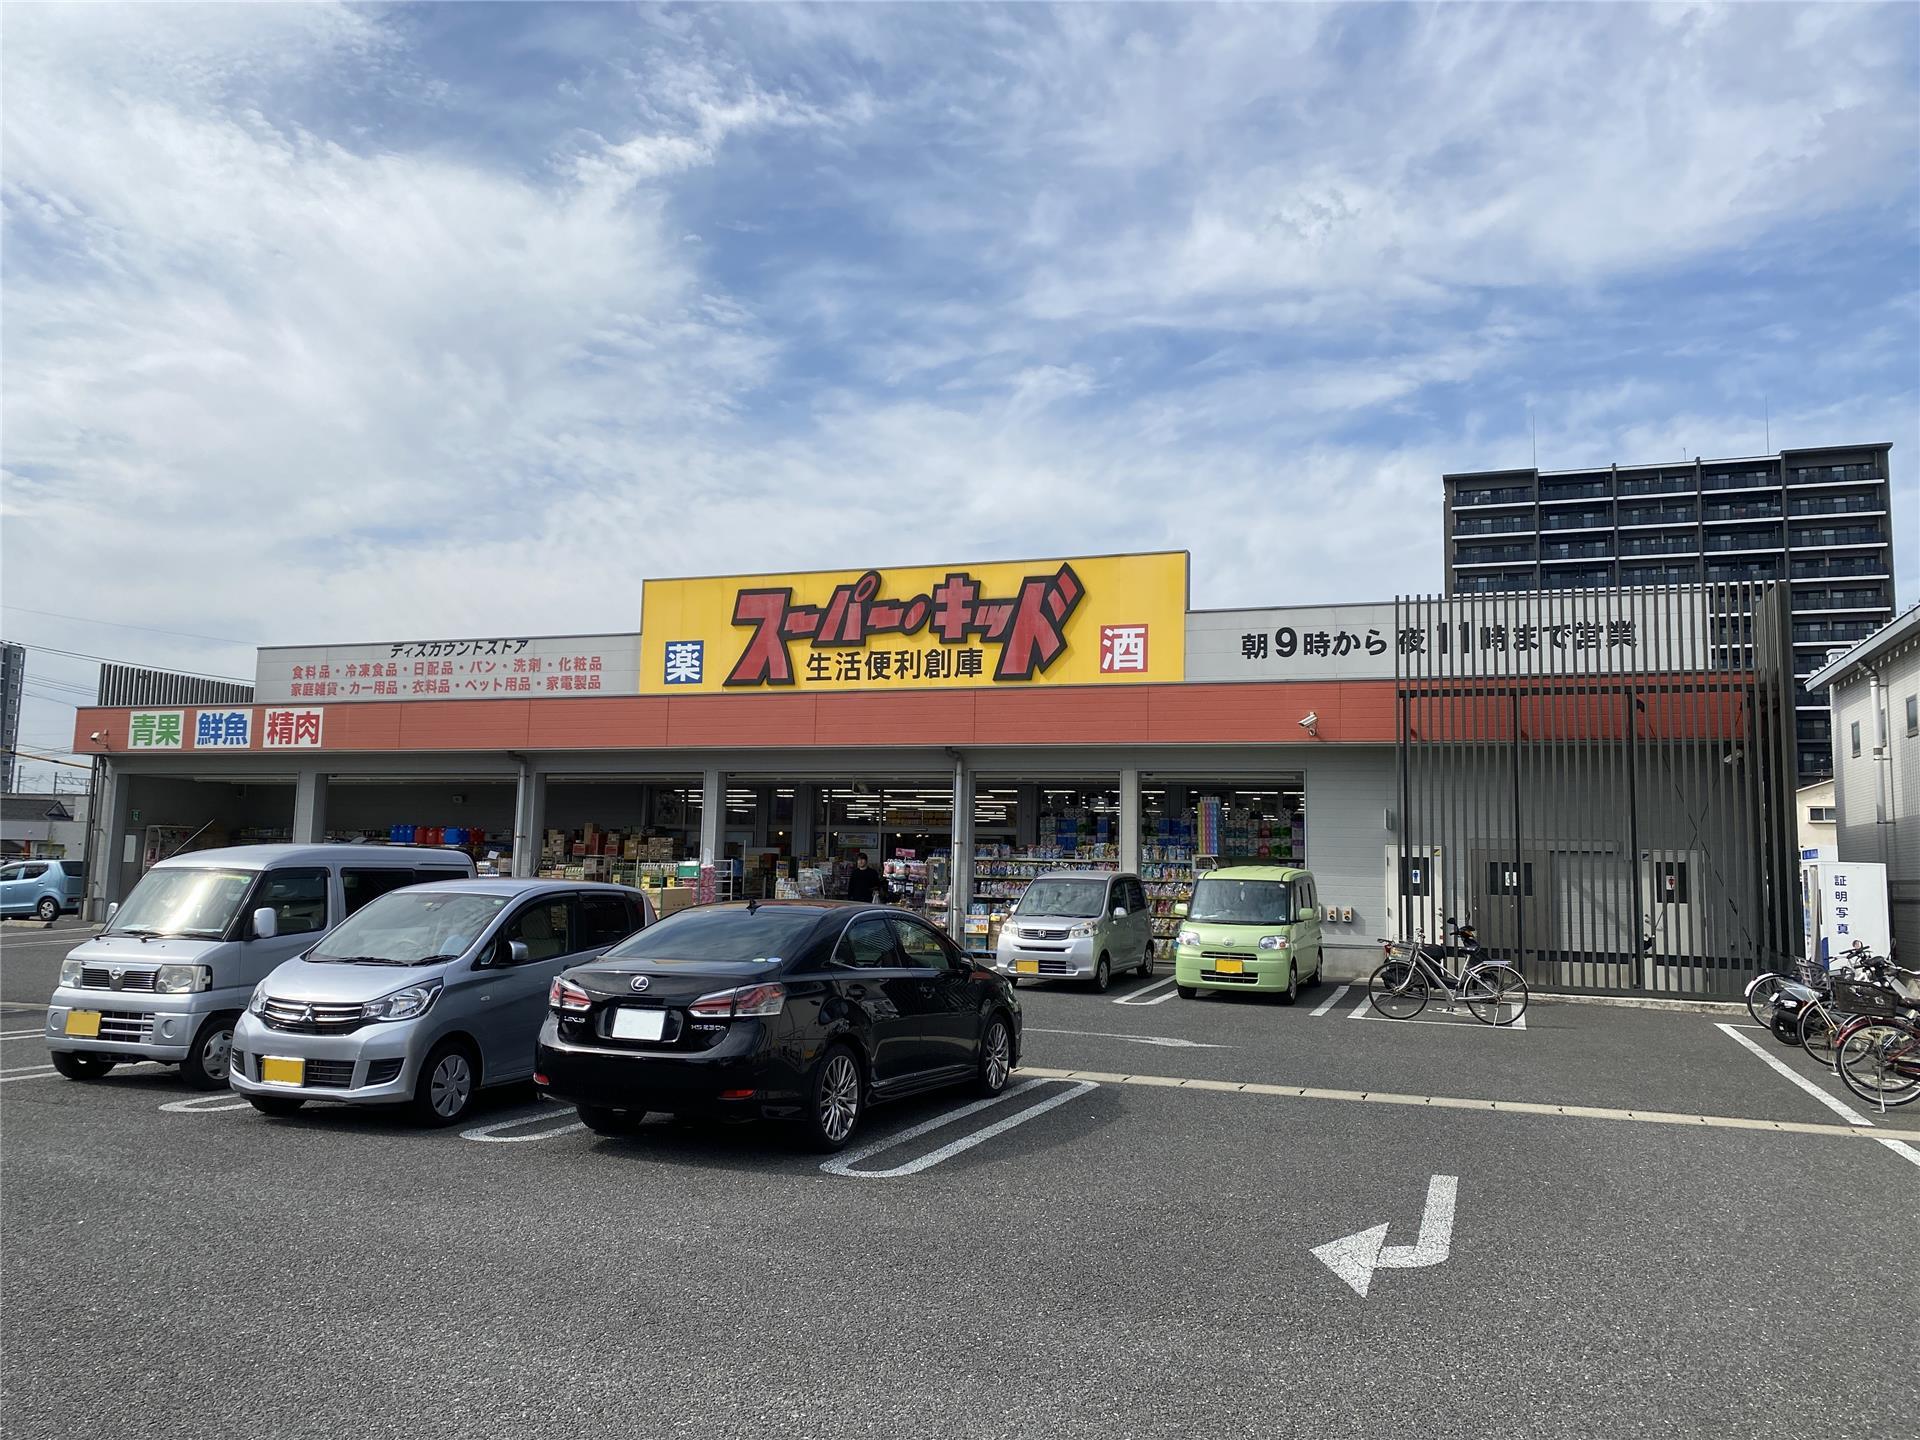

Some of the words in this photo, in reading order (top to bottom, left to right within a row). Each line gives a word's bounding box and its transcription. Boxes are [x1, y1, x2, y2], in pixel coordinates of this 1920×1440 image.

[390, 640, 529, 658] ディスカウントストア
[666, 642, 702, 682] 薬
[805, 648, 984, 682] 生活便利創庫
[1102, 626, 1146, 672] 酒
[131, 713, 180, 746] 青果
[196, 712, 248, 746] 鮮魚
[267, 711, 320, 745] 精肉
[1834, 874, 1849, 935] 証明写真
